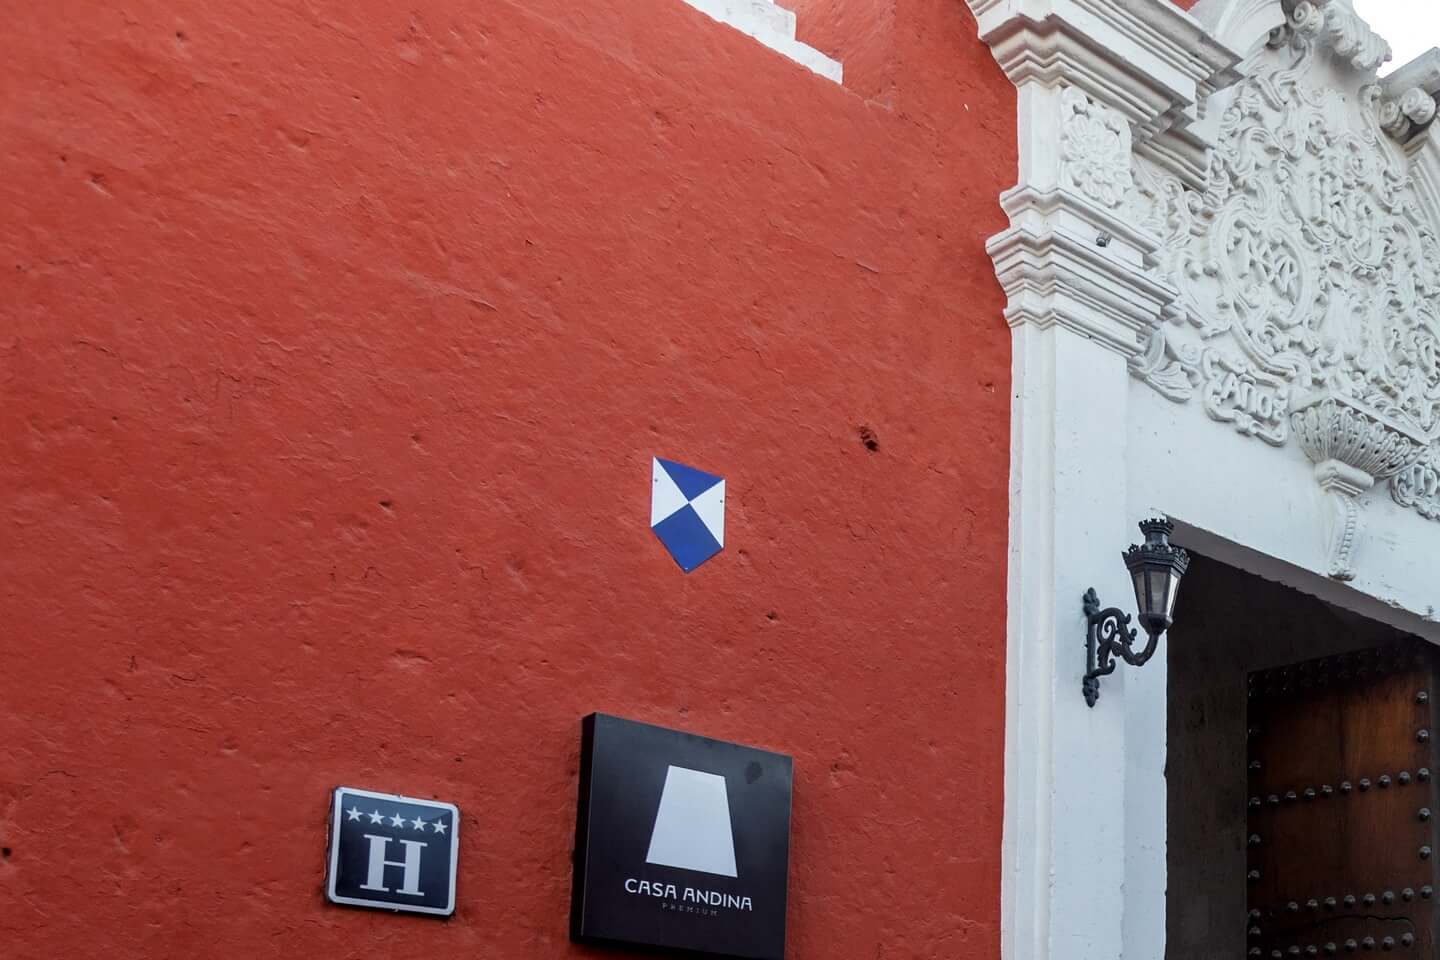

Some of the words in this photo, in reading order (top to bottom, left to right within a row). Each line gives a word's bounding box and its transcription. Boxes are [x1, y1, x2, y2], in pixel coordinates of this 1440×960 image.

[359, 833, 428, 896] H
[624, 878, 677, 899] CASA
[683, 887, 753, 911] ANDINA
